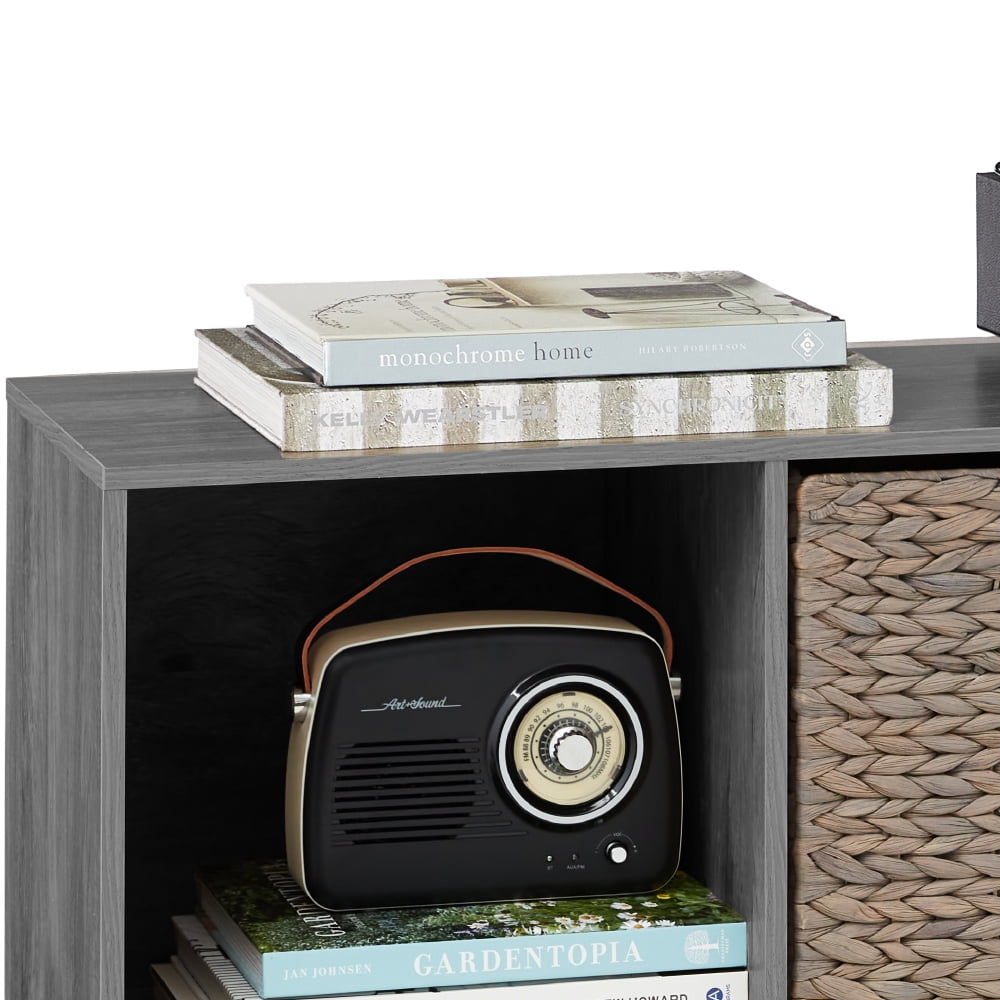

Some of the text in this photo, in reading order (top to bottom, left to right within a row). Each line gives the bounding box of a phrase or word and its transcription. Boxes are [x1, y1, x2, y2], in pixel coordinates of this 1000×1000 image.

[378, 341, 594, 367] monochrome home
[639, 342, 747, 355] HILARY ROBERTSON
[534, 715, 541, 723] 92
[583, 704, 593, 714] 100
[594, 712, 604, 723] 102
[413, 939, 645, 977] GARDENTOPIA
[283, 963, 372, 981] JAN JOHNSEN
